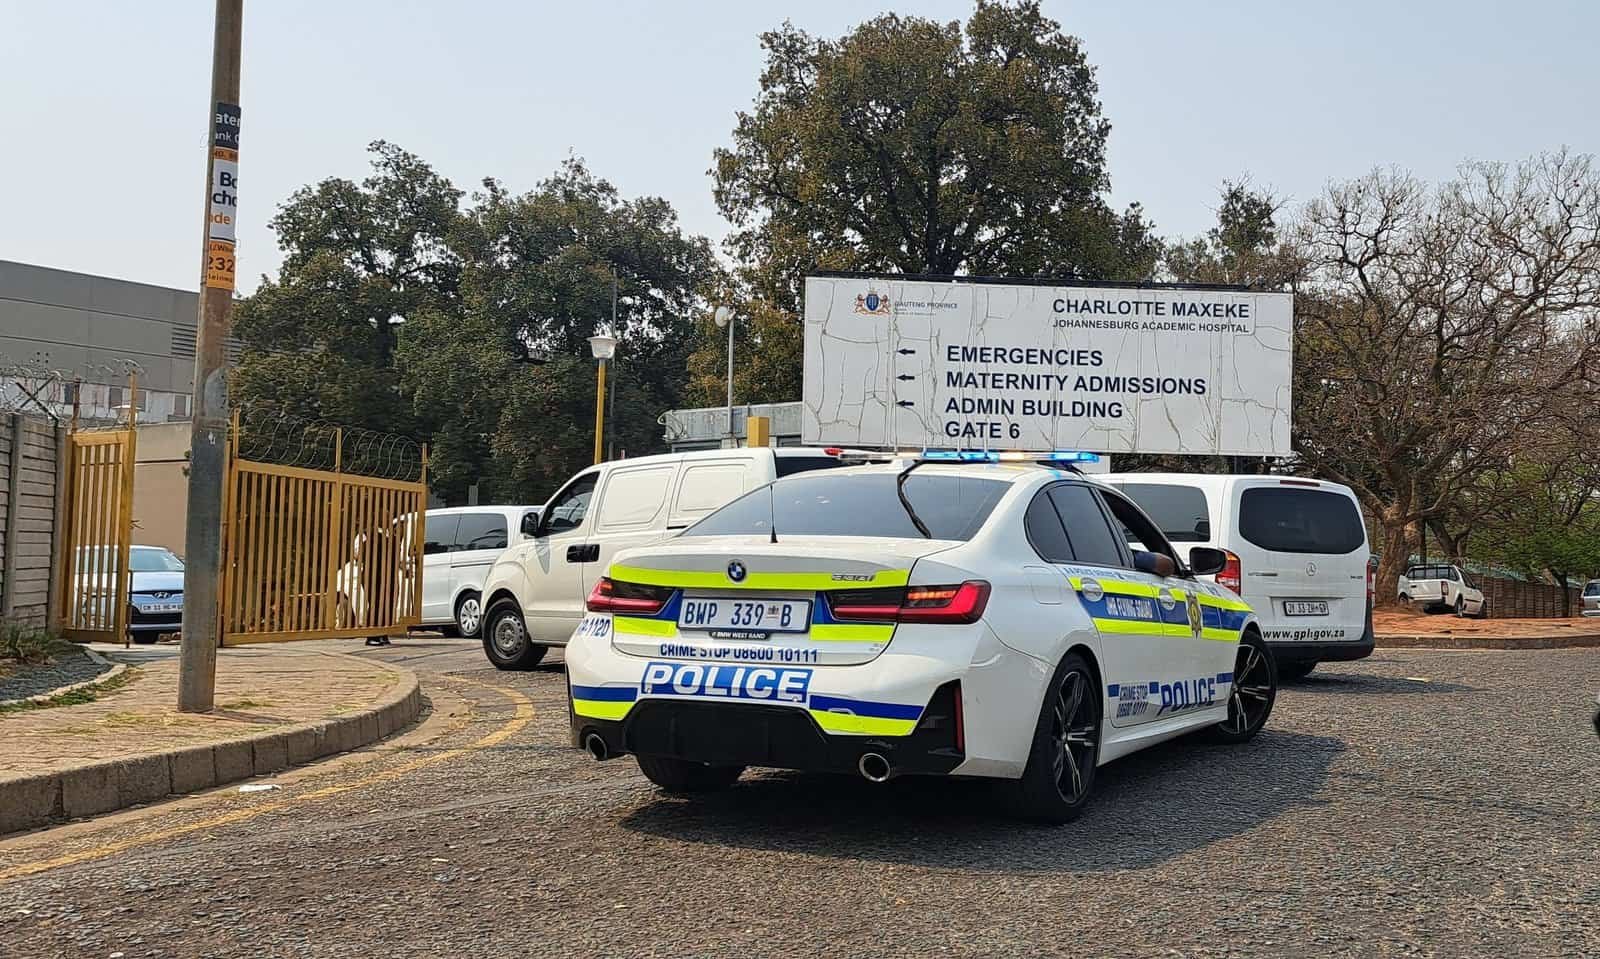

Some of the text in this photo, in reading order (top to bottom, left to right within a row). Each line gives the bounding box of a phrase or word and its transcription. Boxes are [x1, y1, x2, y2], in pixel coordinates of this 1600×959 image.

[1053, 299, 1249, 318] CHARLOTTE MAXEKE
[1053, 319, 1249, 333] JOHANNESBURG ACADEMIC HOSPITAL
[947, 345, 1104, 366] EMERGENCIES
[946, 371, 1207, 395] MATERNITY ADMISSIONS
[945, 397, 1123, 418] ADMIN BUILDING
[945, 421, 1021, 440] GATE 6
[684, 602, 792, 627] BWP 339 B
[1262, 628, 1345, 641] www.gpl.gov.za
[660, 643, 697, 657] CRIME
[700, 647, 730, 659] STOP
[778, 648, 818, 663] 10111
[644, 664, 809, 701] POLICE
[1157, 677, 1216, 716] POLICE
